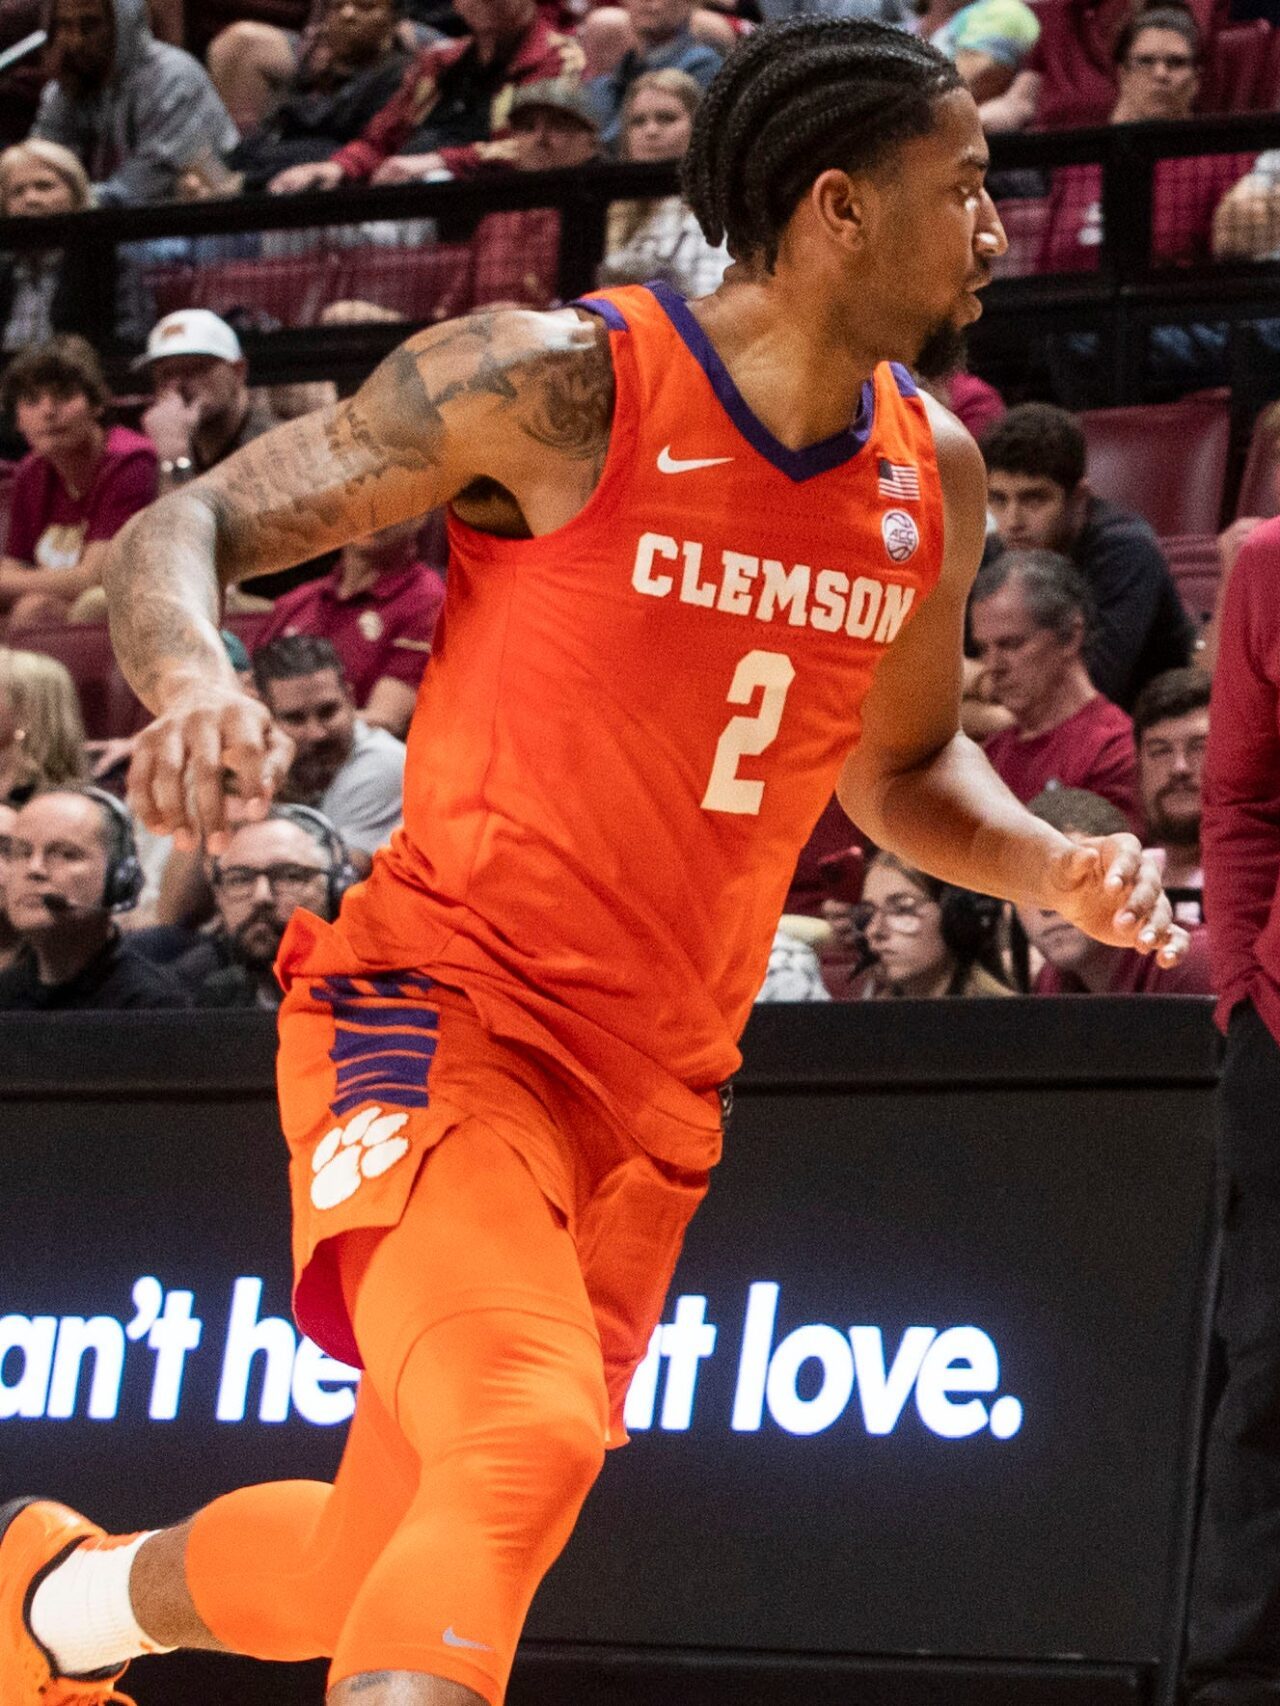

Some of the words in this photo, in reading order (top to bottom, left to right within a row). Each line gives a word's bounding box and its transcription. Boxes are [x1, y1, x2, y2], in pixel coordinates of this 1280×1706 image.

[632, 532, 916, 643] CLEMSON
[700, 649, 796, 815] 2
[731, 1281, 1023, 1440] love.
